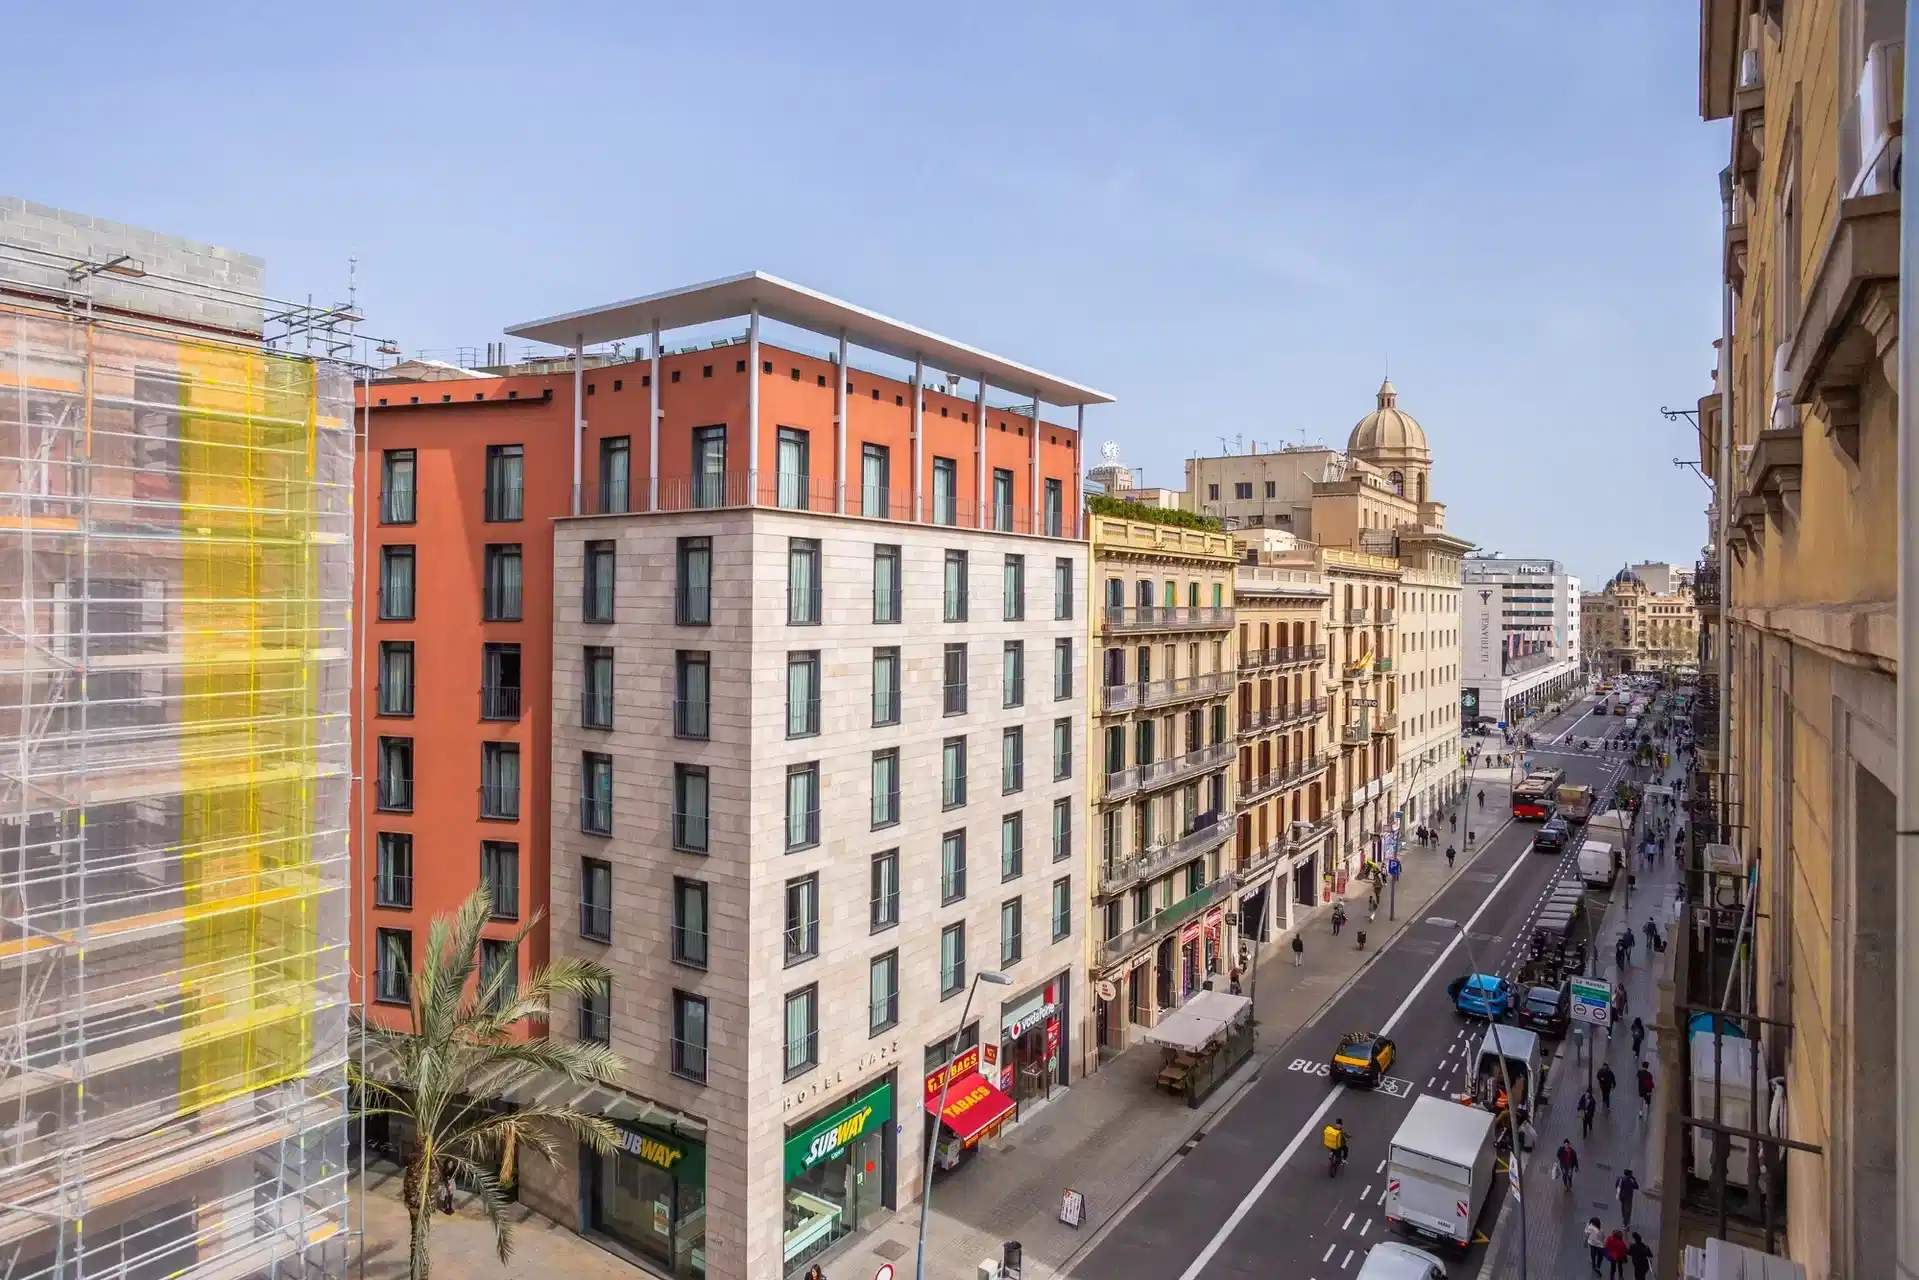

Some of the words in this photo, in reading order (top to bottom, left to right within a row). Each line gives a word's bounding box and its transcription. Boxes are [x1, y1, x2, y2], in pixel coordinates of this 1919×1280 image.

[1520, 563, 1548, 573] fnac
[1022, 1003, 1055, 1030] vodafone
[782, 1071, 843, 1112] HOTEL
[859, 1040, 899, 1071] JAZZ
[938, 1053, 977, 1086] TBACS
[1287, 1058, 1330, 1077] BUS
[943, 1086, 991, 1118] TABACS
[805, 1106, 872, 1165] SUBWAY
